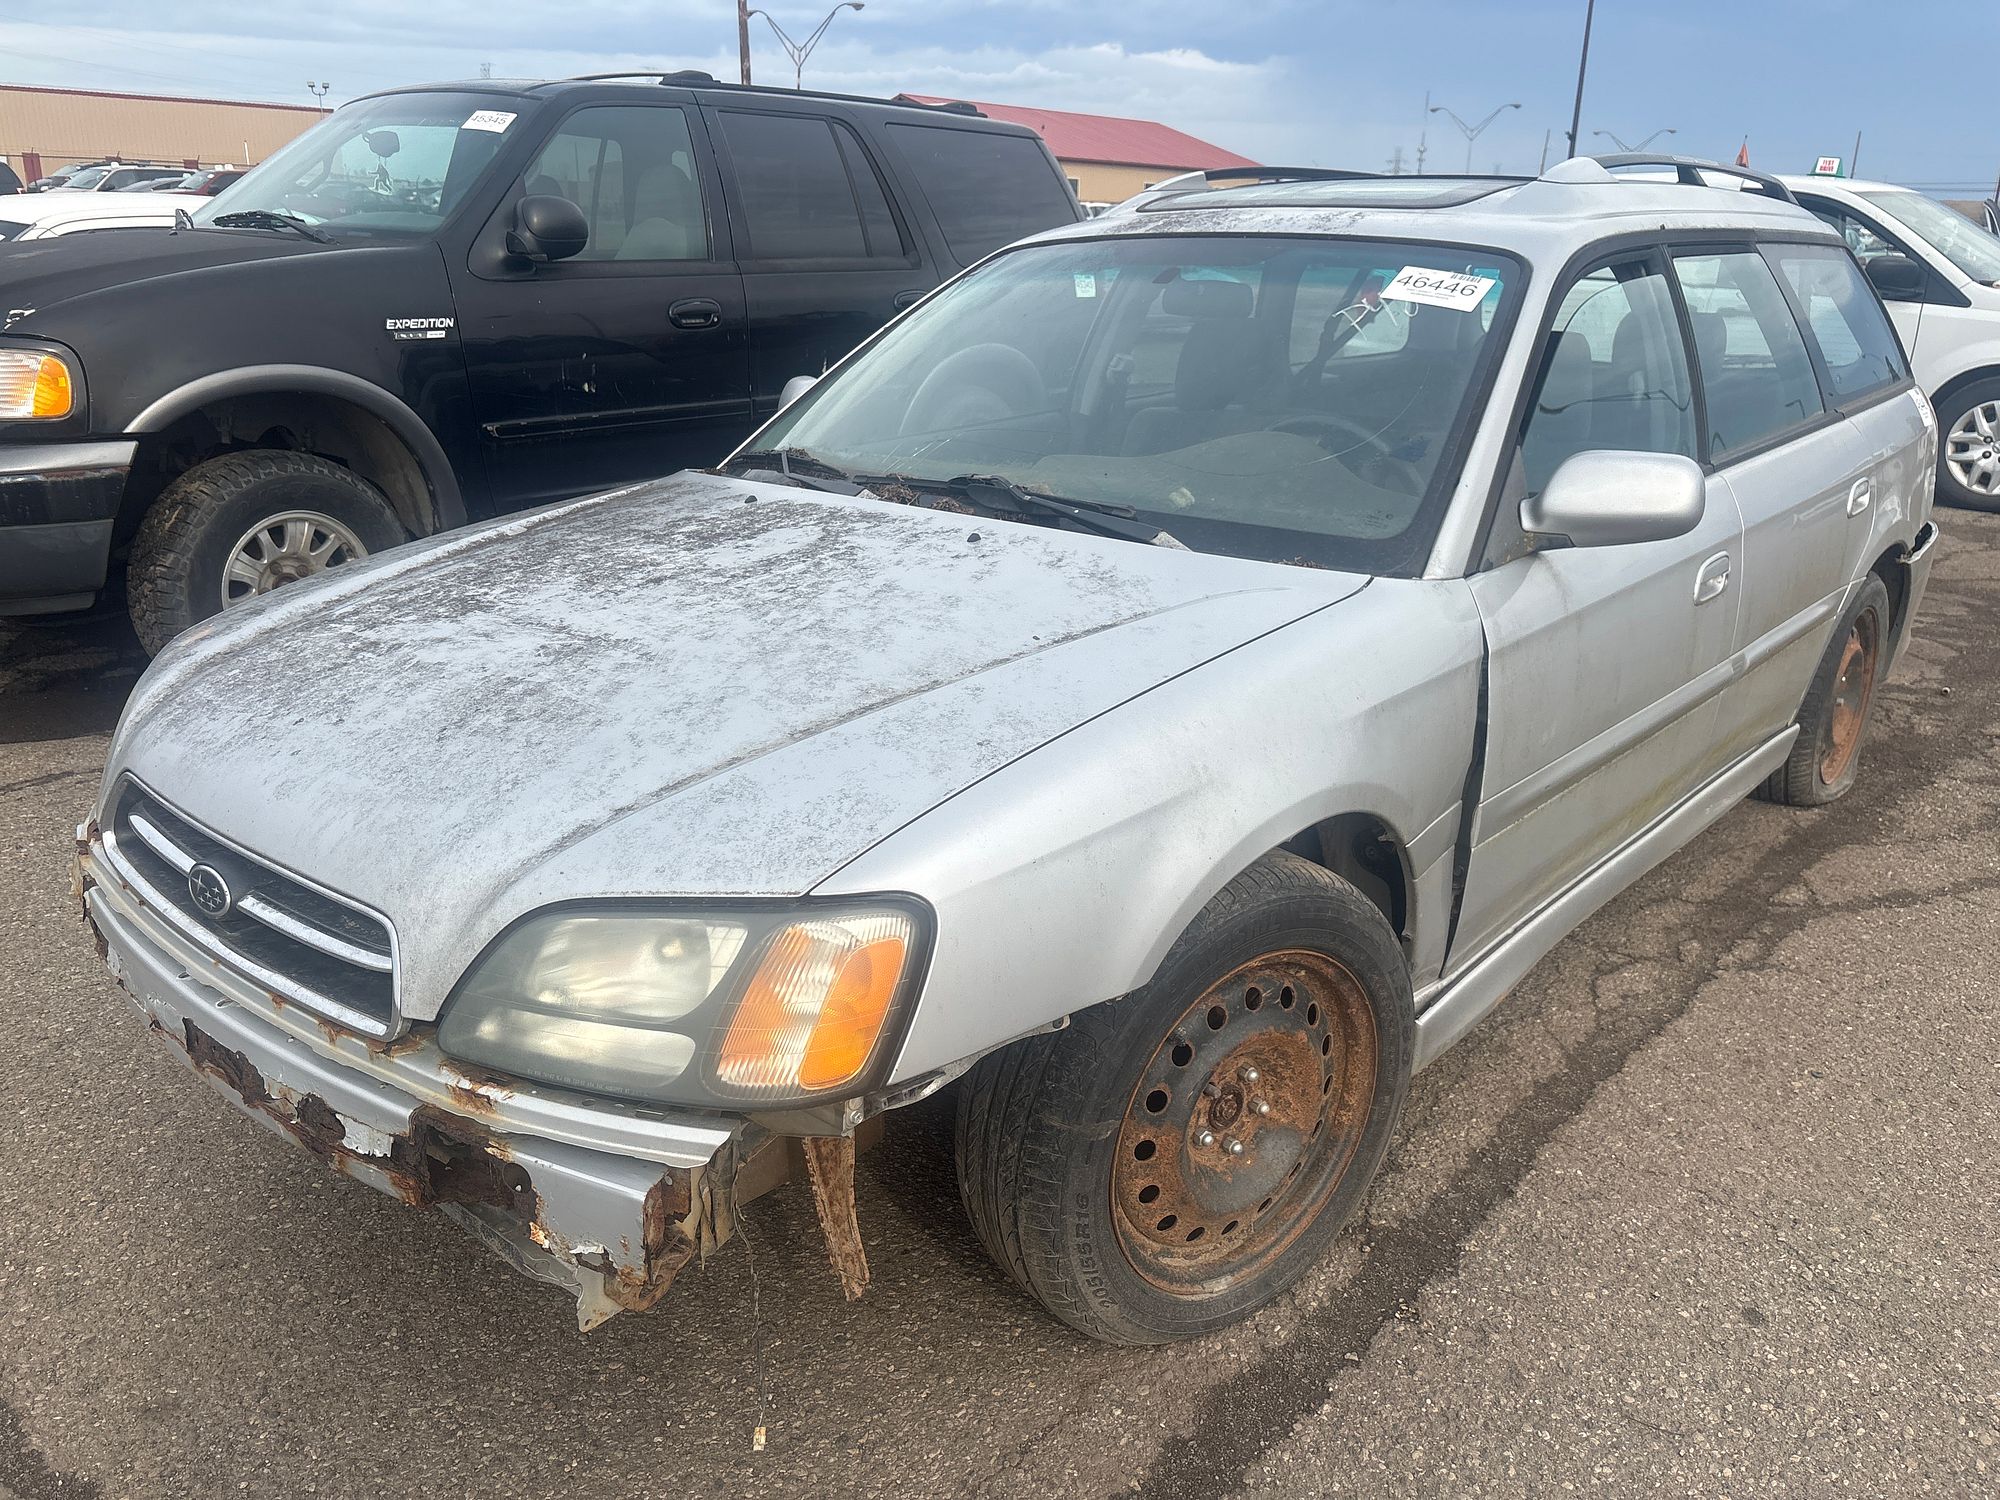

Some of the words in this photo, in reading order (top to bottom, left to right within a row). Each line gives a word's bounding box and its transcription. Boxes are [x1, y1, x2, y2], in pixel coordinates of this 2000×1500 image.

[471, 115, 508, 124] 45345
[1396, 274, 1478, 297] 46446
[386, 317, 454, 329] EXPEDITION
